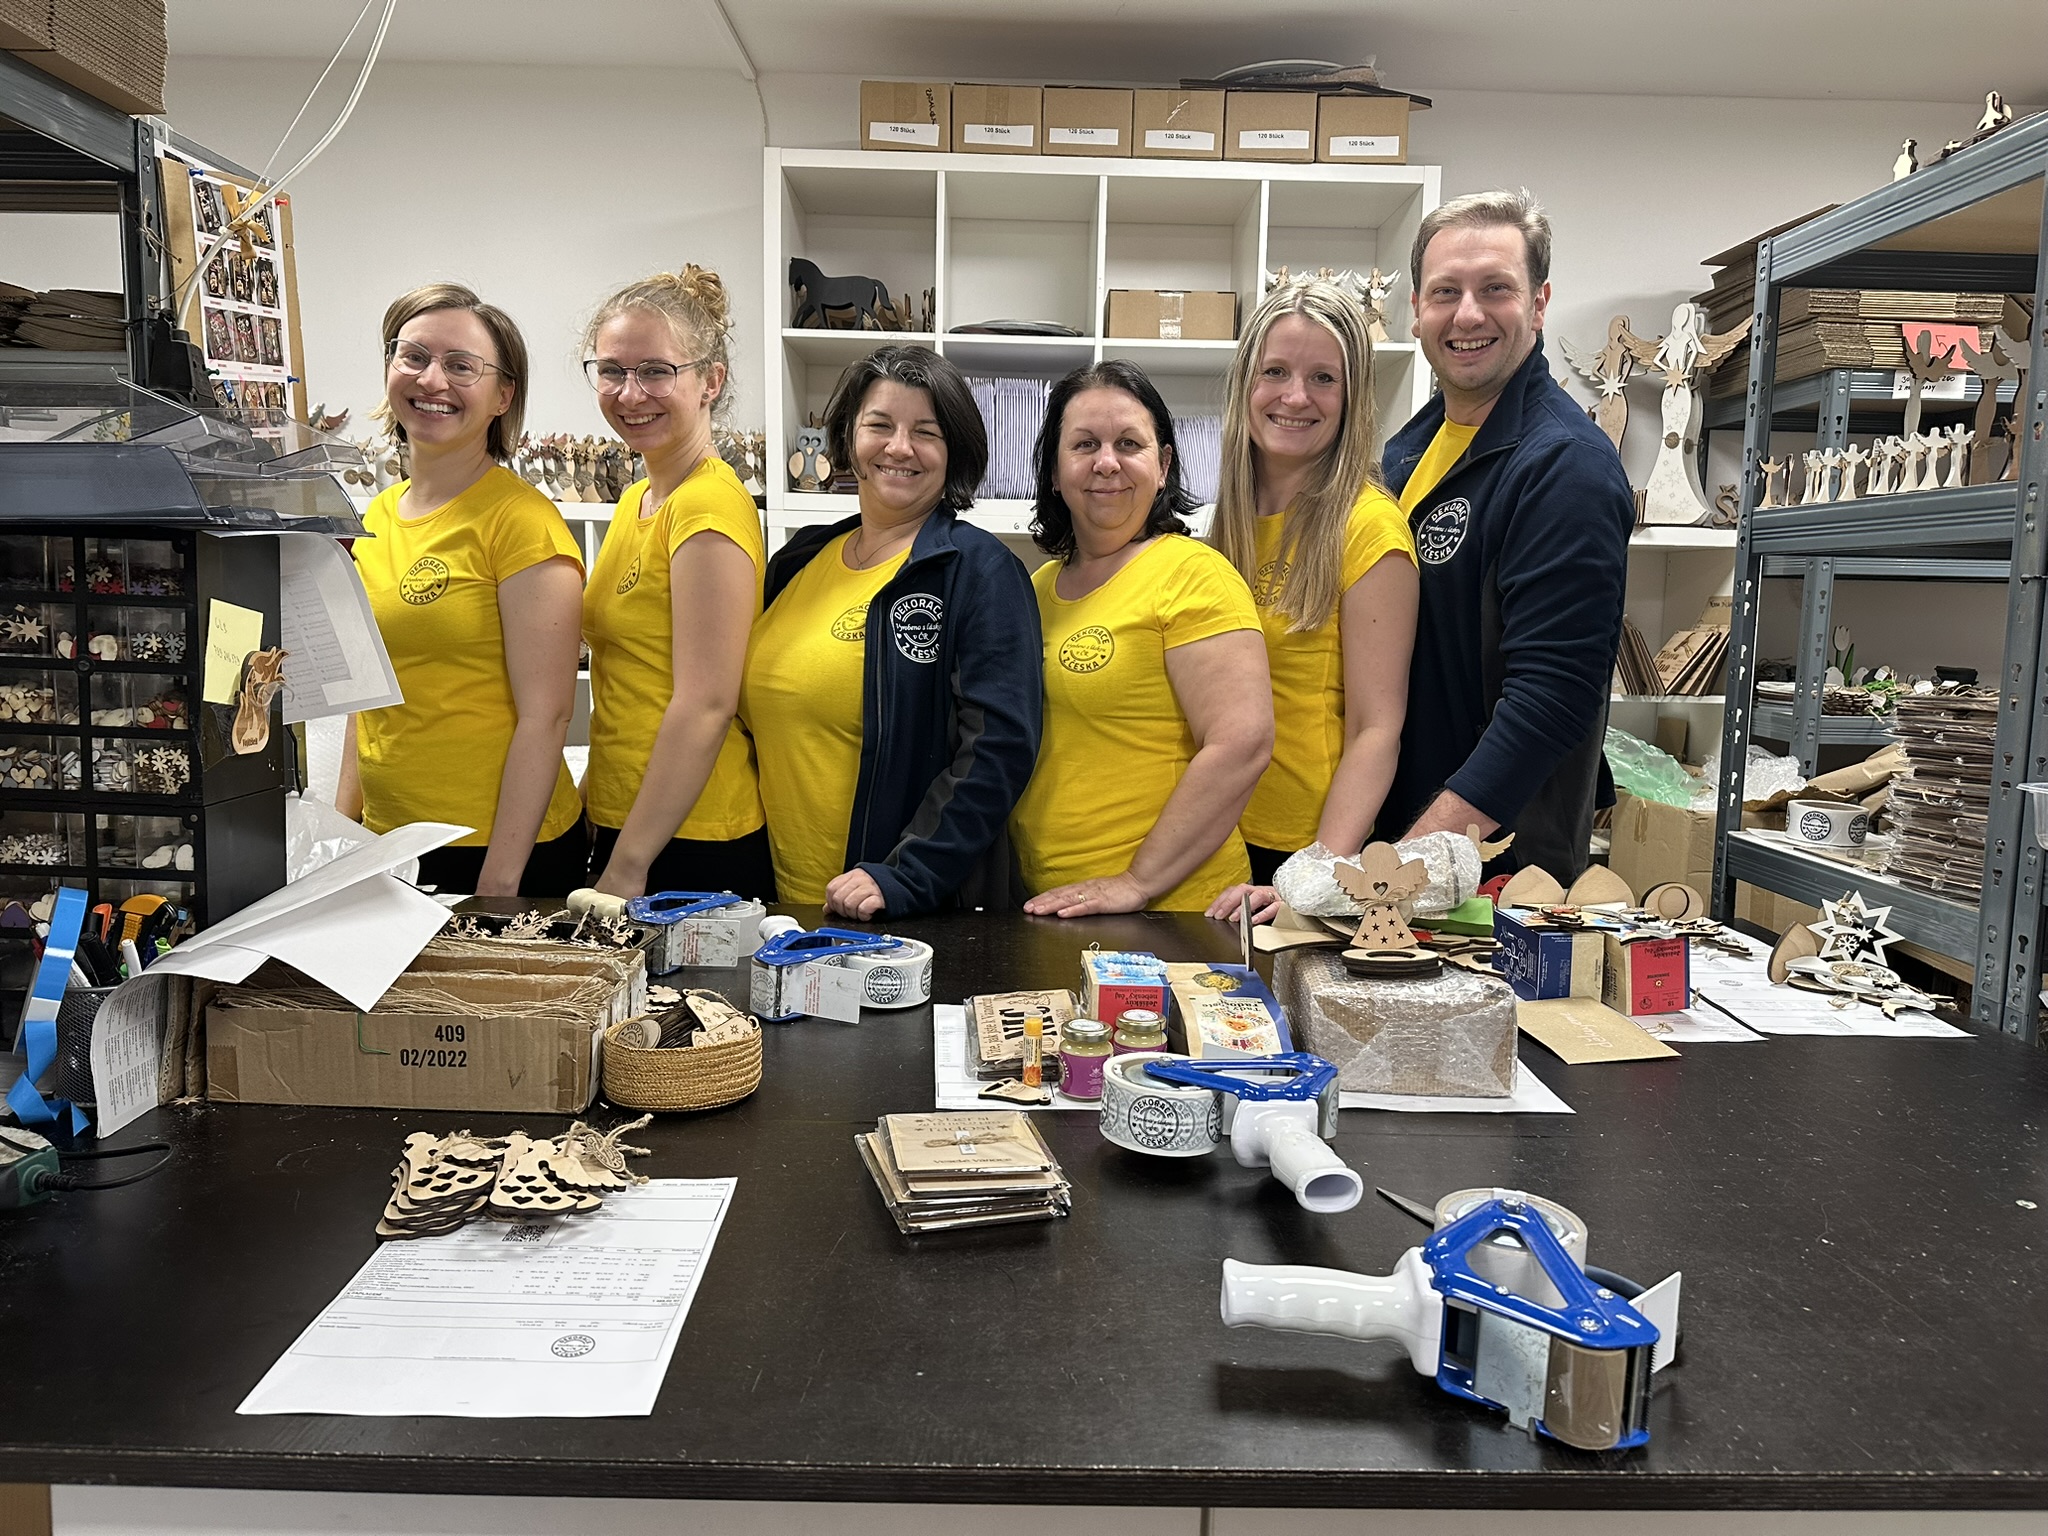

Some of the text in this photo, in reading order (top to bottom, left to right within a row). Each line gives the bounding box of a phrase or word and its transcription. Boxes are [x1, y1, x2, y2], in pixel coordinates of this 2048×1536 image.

[900, 126, 916, 134] Stück
[1431, 502, 1467, 523] DEKORACE
[1424, 546, 1453, 560] ČESKA
[409, 559, 446, 576] DEKORACE
[894, 599, 944, 620] DEKORACE
[1070, 628, 1110, 645] DEKORACE
[902, 641, 911, 652] Z
[1068, 659, 1099, 671] ČESKA
[435, 1025, 465, 1042] 409
[400, 1049, 467, 1068] 02/2022
[1133, 1098, 1174, 1119] DEKORACE
